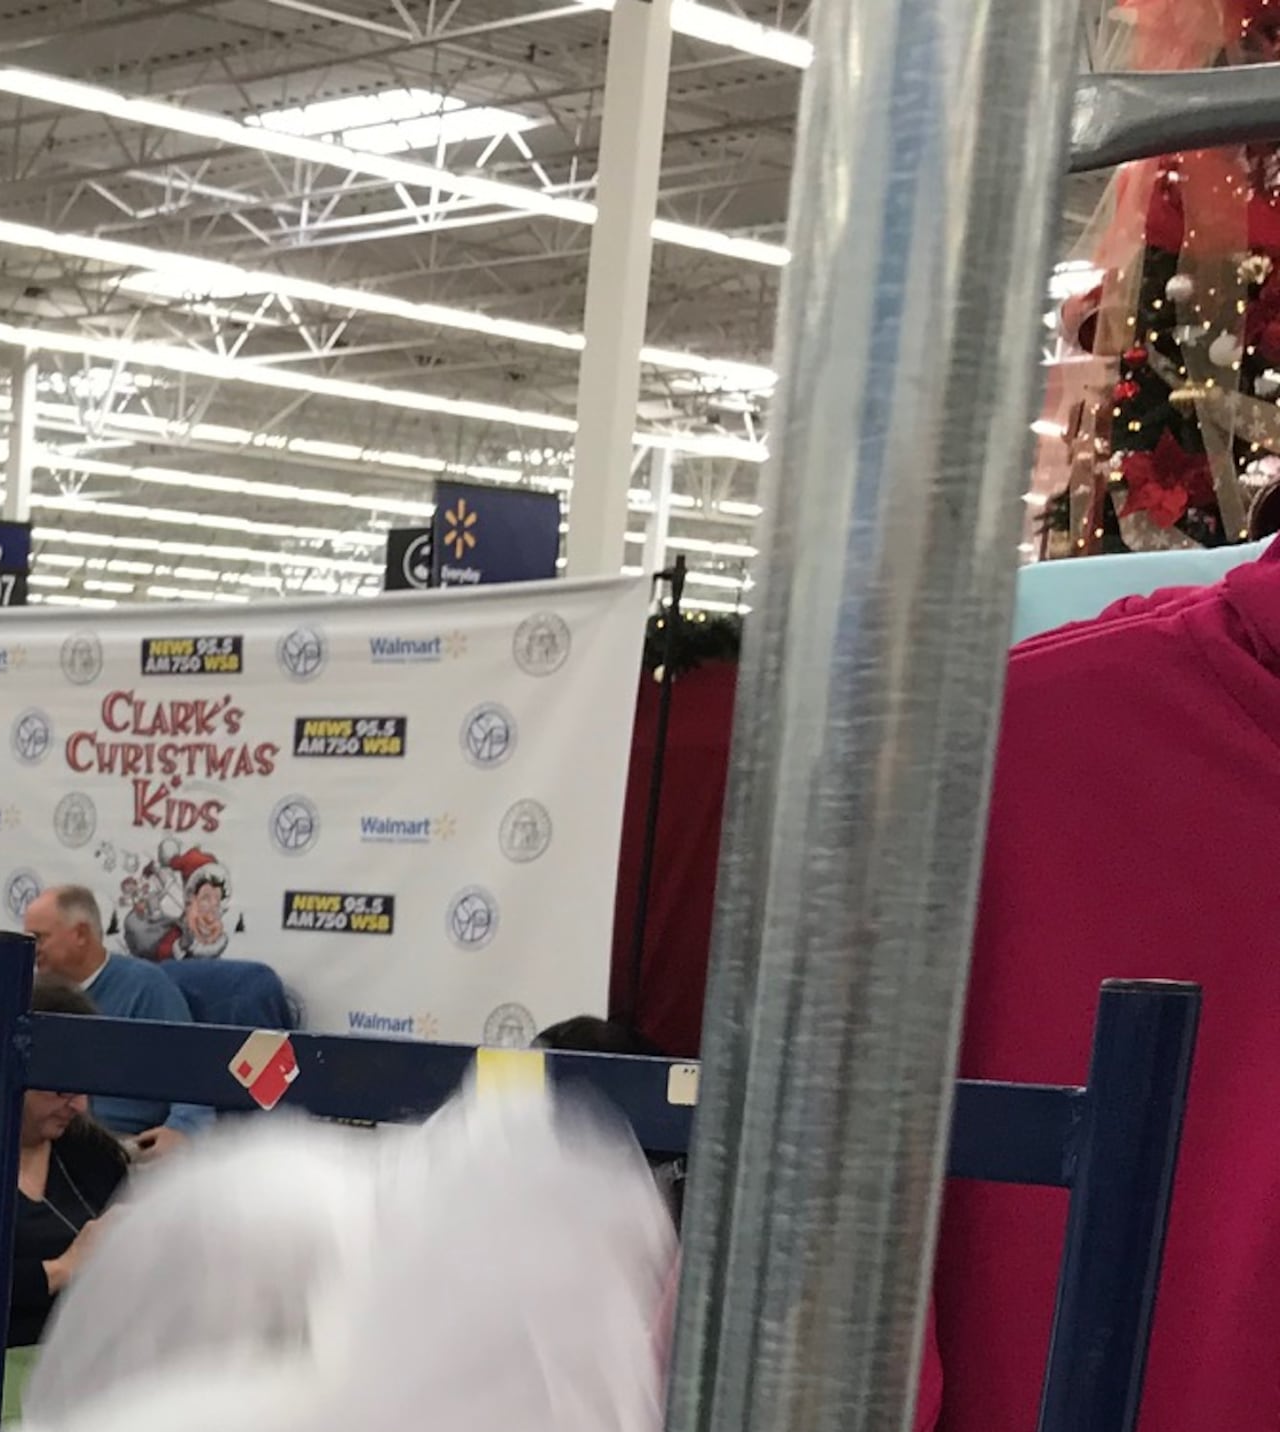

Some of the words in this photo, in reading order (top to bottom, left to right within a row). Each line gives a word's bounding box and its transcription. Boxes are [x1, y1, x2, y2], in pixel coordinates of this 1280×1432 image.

[148, 638, 194, 657] NEWS
[196, 636, 234, 656] 95.5
[370, 636, 442, 657] Walmart
[203, 653, 239, 672] WSB
[303, 718, 354, 738] NEWS
[355, 718, 397, 737] 95.5
[65, 730, 281, 781] CHRISTMAS
[362, 736, 403, 754] WSB
[360, 814, 431, 836] Walmart
[292, 893, 342, 913] NEWS
[343, 895, 384, 915] 95.5
[350, 913, 390, 932] WSB
[347, 1010, 415, 1035] Walmart
